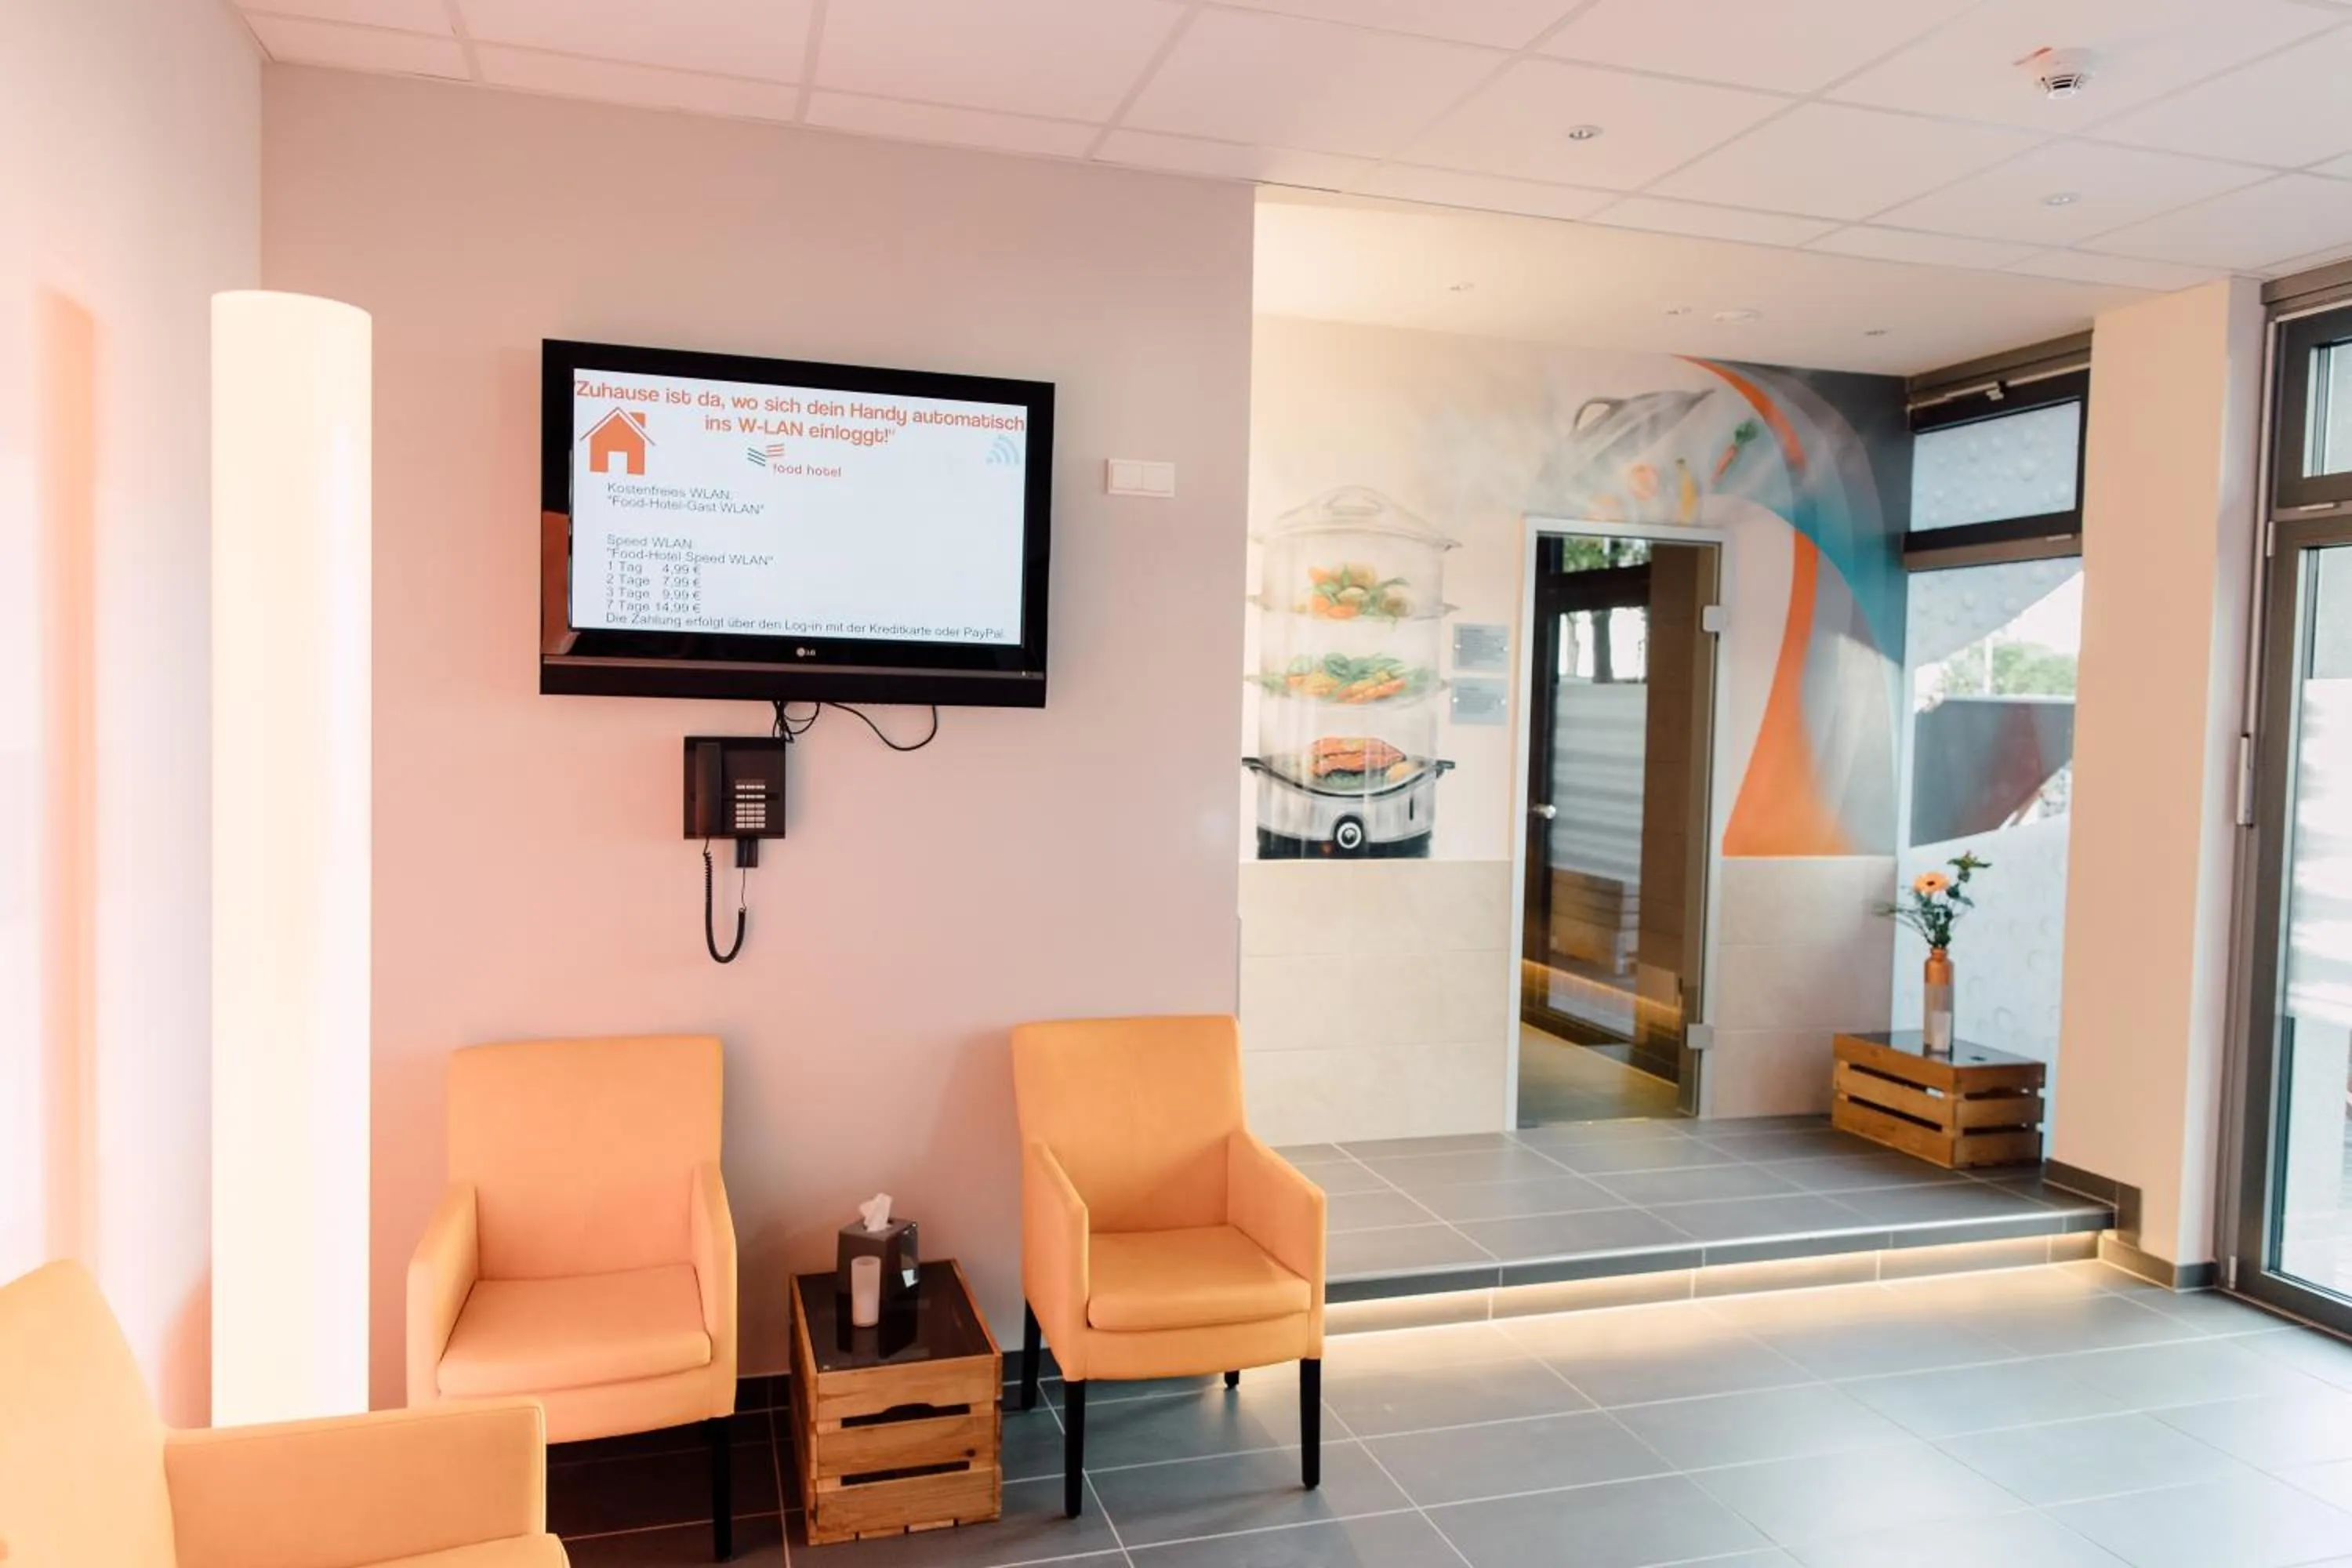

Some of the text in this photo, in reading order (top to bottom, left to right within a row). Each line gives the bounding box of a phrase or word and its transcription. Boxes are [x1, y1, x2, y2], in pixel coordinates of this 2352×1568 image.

[666, 388, 691, 405] ist
[697, 390, 725, 410] da,
[731, 396, 759, 411] wo
[764, 394, 800, 414] sich
[806, 399, 844, 417] dein
[850, 402, 908, 427] Handy
[912, 409, 1025, 432] automatisch
[705, 414, 731, 431] ins
[738, 416, 804, 437] W-LAN
[773, 463, 842, 477] food hotel
[607, 482, 686, 498] Kostenfreies
[607, 534, 648, 549] Speed
[685, 550, 726, 564] Speed
[608, 561, 701, 576] 1 Tag 4,99 €
[606, 574, 701, 588] 2 Tage 7,99 €
[606, 587, 615, 597] 3
[619, 587, 650, 600] Tage
[692, 590, 701, 601] €
[606, 600, 701, 614] 7 Tage 14,99 €
[606, 612, 627, 623] Die
[631, 612, 681, 627] Zahlung
[685, 615, 724, 629] erfolgt
[728, 616, 756, 629] über
[759, 618, 781, 629] den
[785, 619, 822, 633] Log-in
[826, 622, 844, 633] mit
[847, 622, 866, 633] der
[869, 623, 932, 637] Kreditkarte
[935, 626, 960, 638] oder
